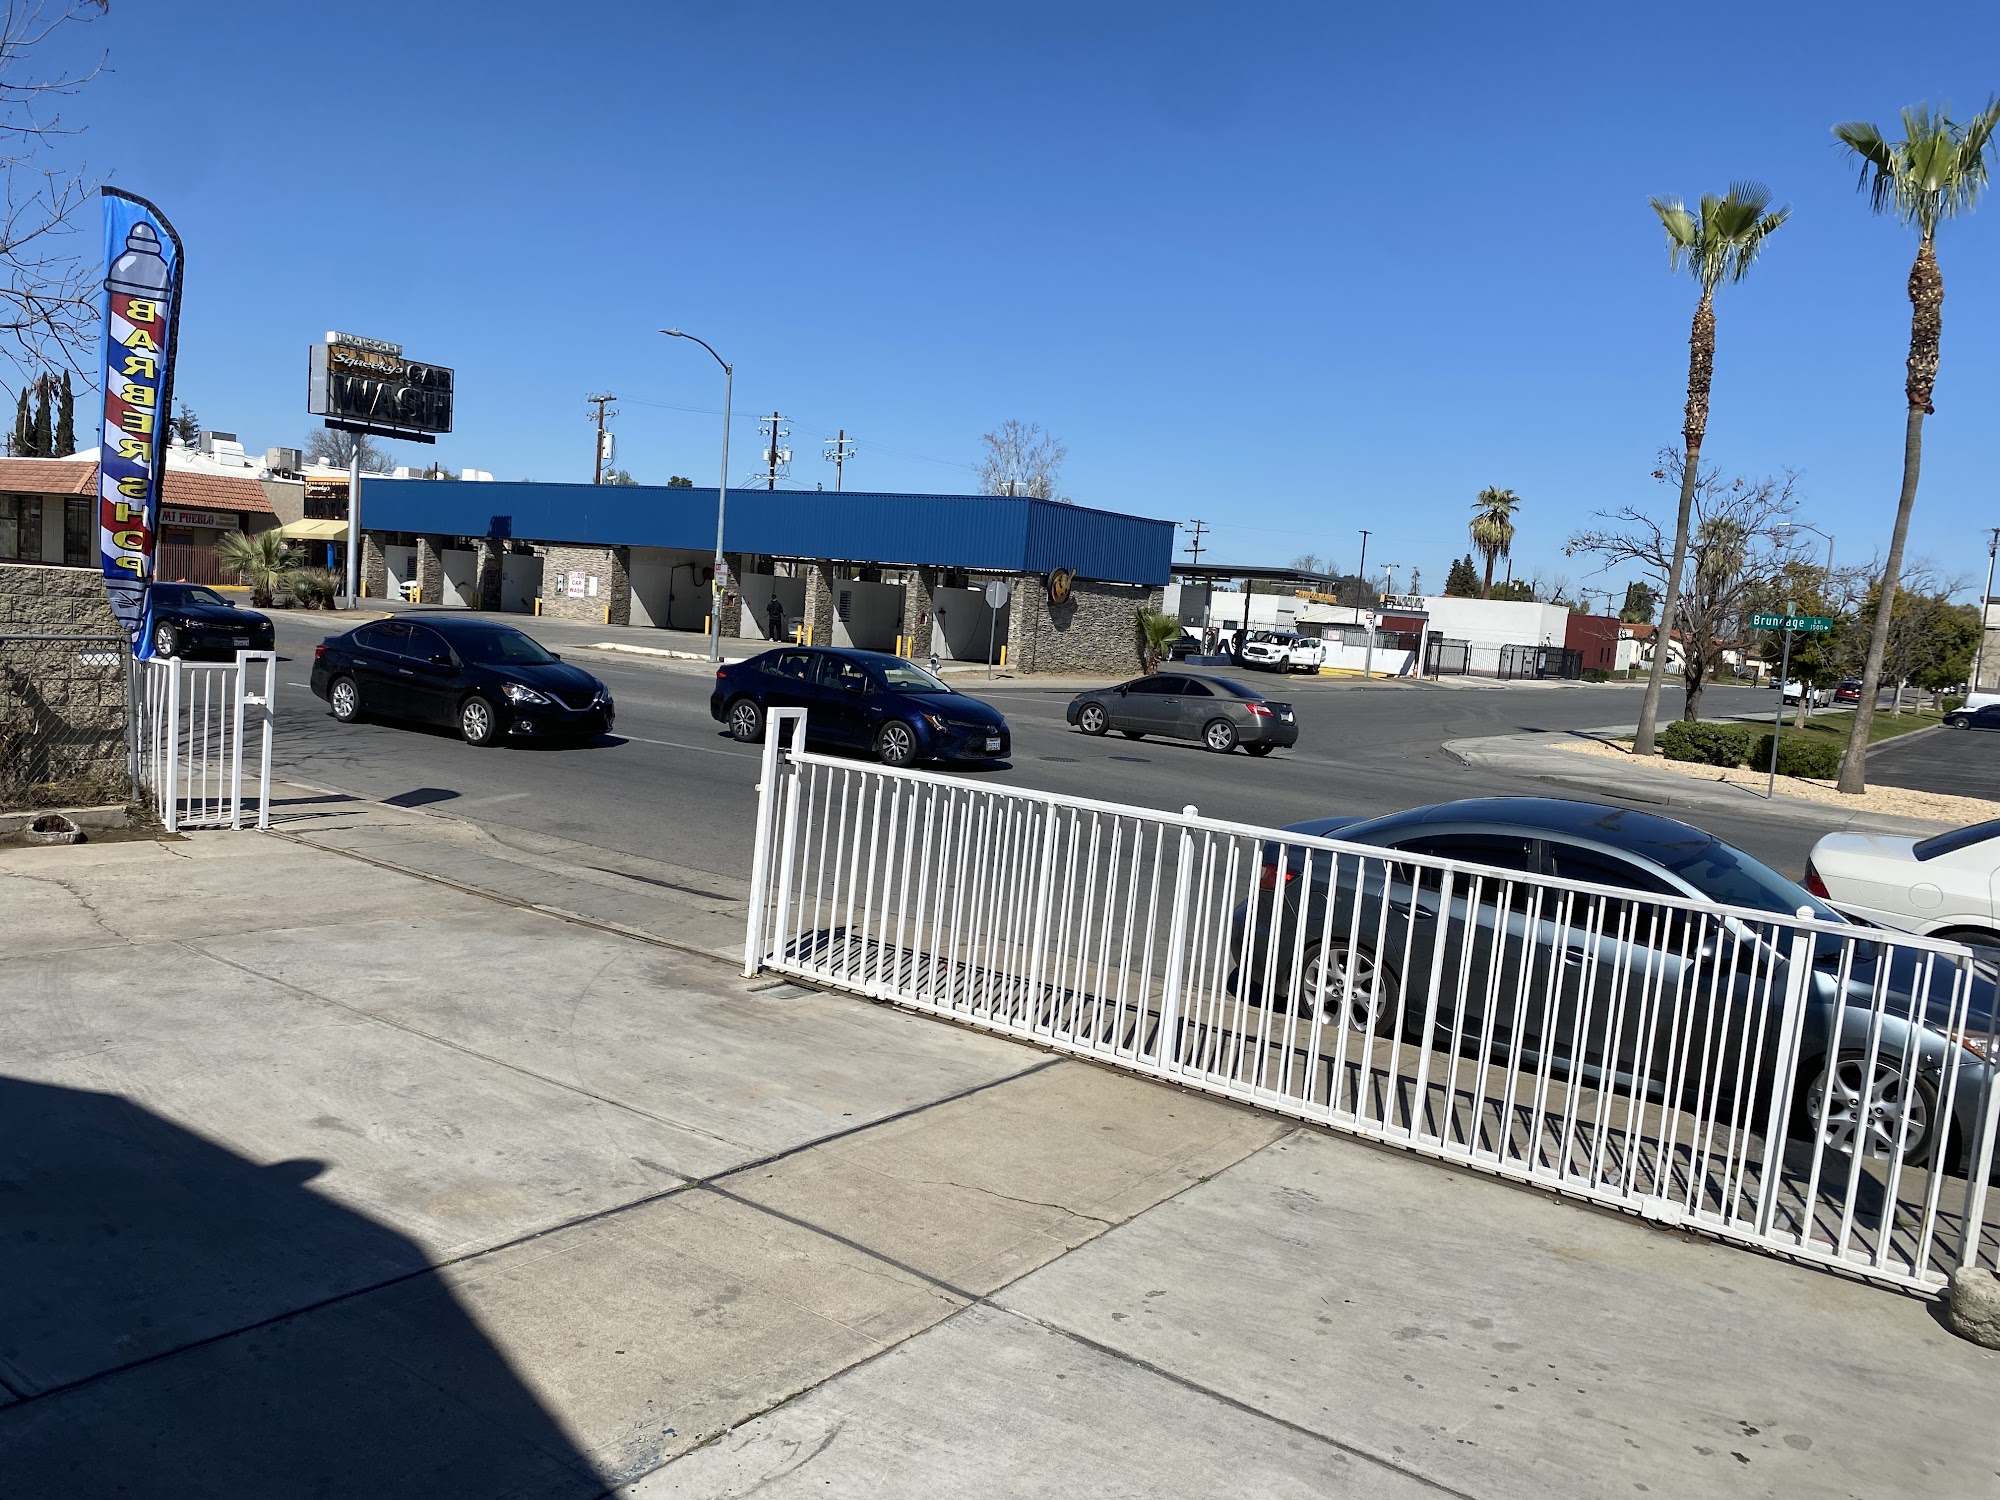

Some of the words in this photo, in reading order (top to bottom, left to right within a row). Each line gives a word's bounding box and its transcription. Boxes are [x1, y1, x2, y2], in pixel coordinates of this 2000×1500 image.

[333, 353, 404, 375] Squeeky's
[407, 364, 451, 388] CAR
[332, 374, 451, 428] WASH
[162, 511, 176, 522] MI
[179, 512, 215, 525] PUEBLO
